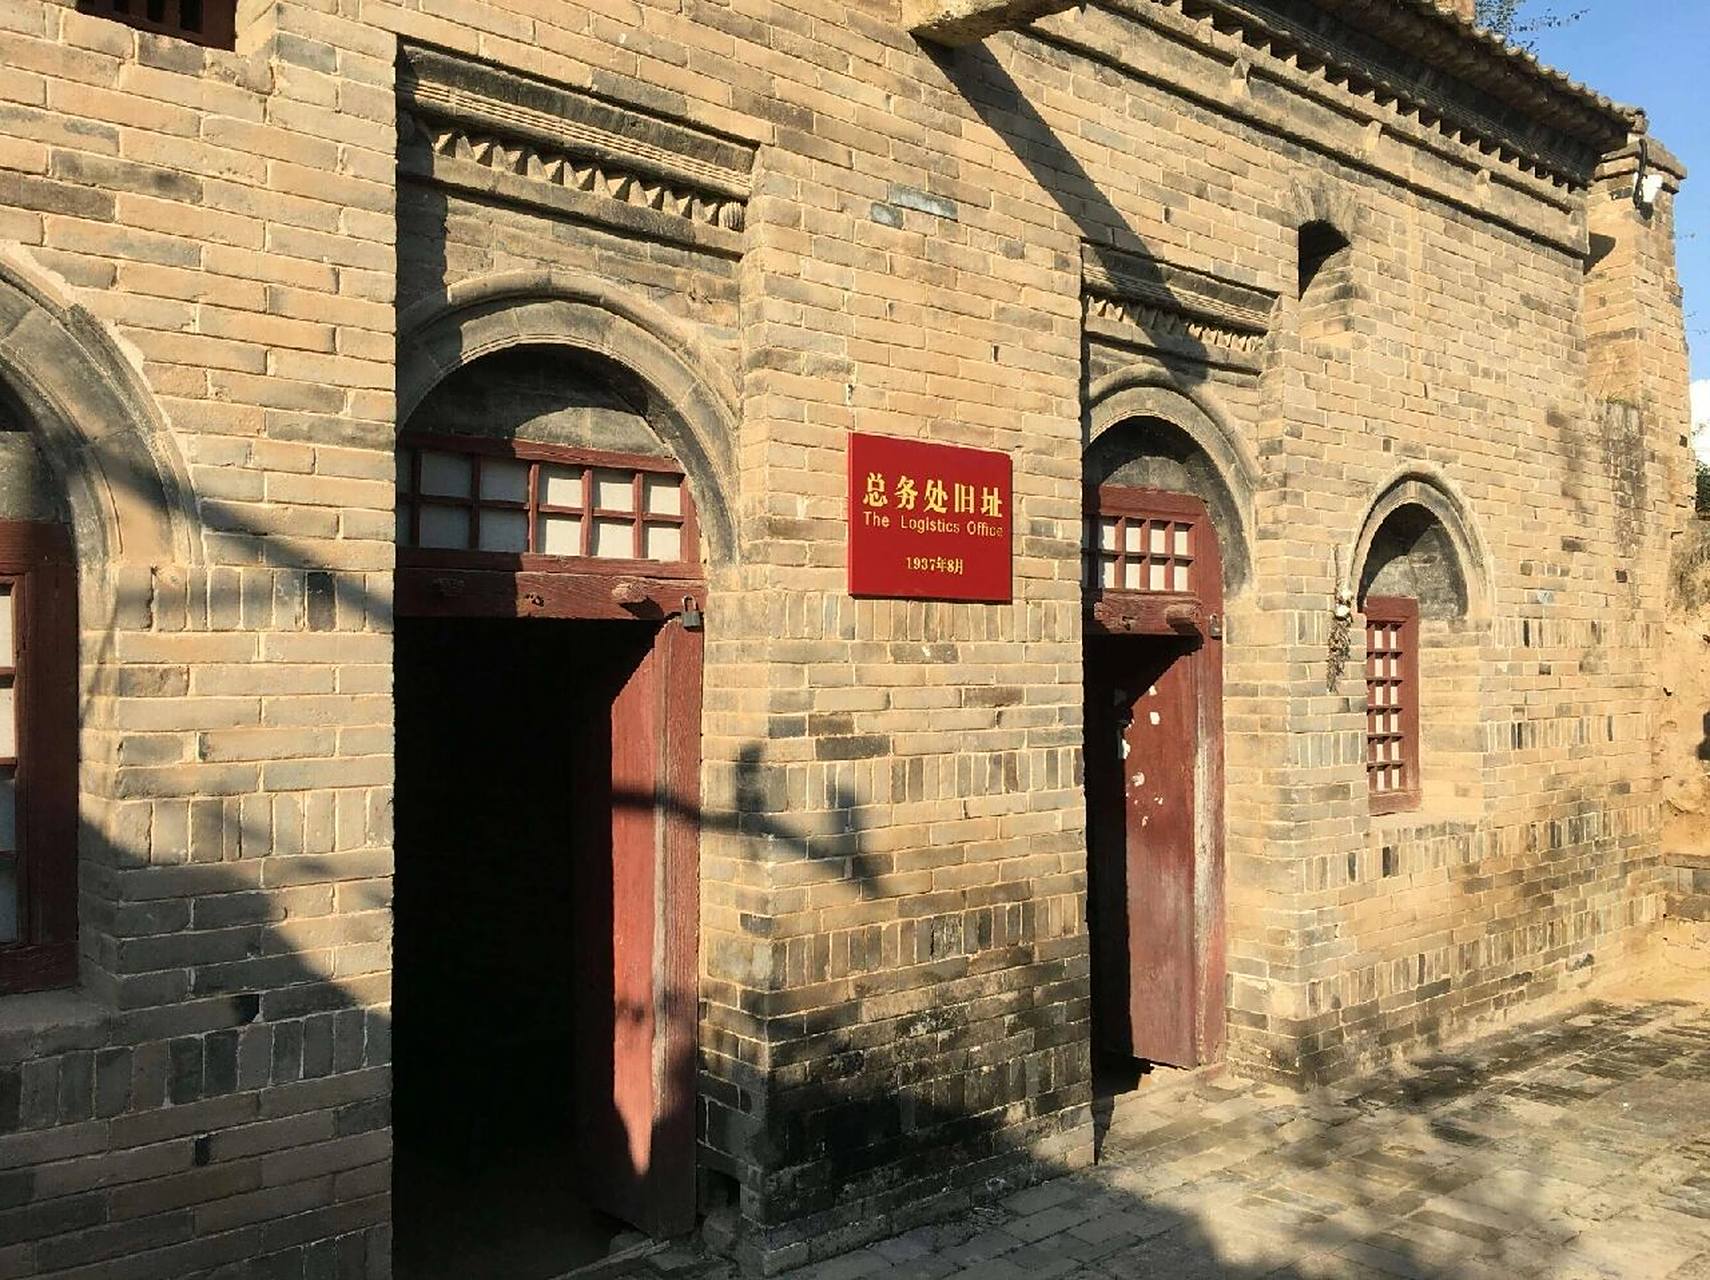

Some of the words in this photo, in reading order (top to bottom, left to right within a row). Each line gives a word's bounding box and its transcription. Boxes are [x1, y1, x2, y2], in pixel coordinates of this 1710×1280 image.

[862, 472, 1003, 517] 总务处旧址
[863, 511, 890, 527] The
[901, 515, 960, 533] Logistics
[966, 521, 1003, 536] Office
[906, 557, 963, 575] 1937年8月
